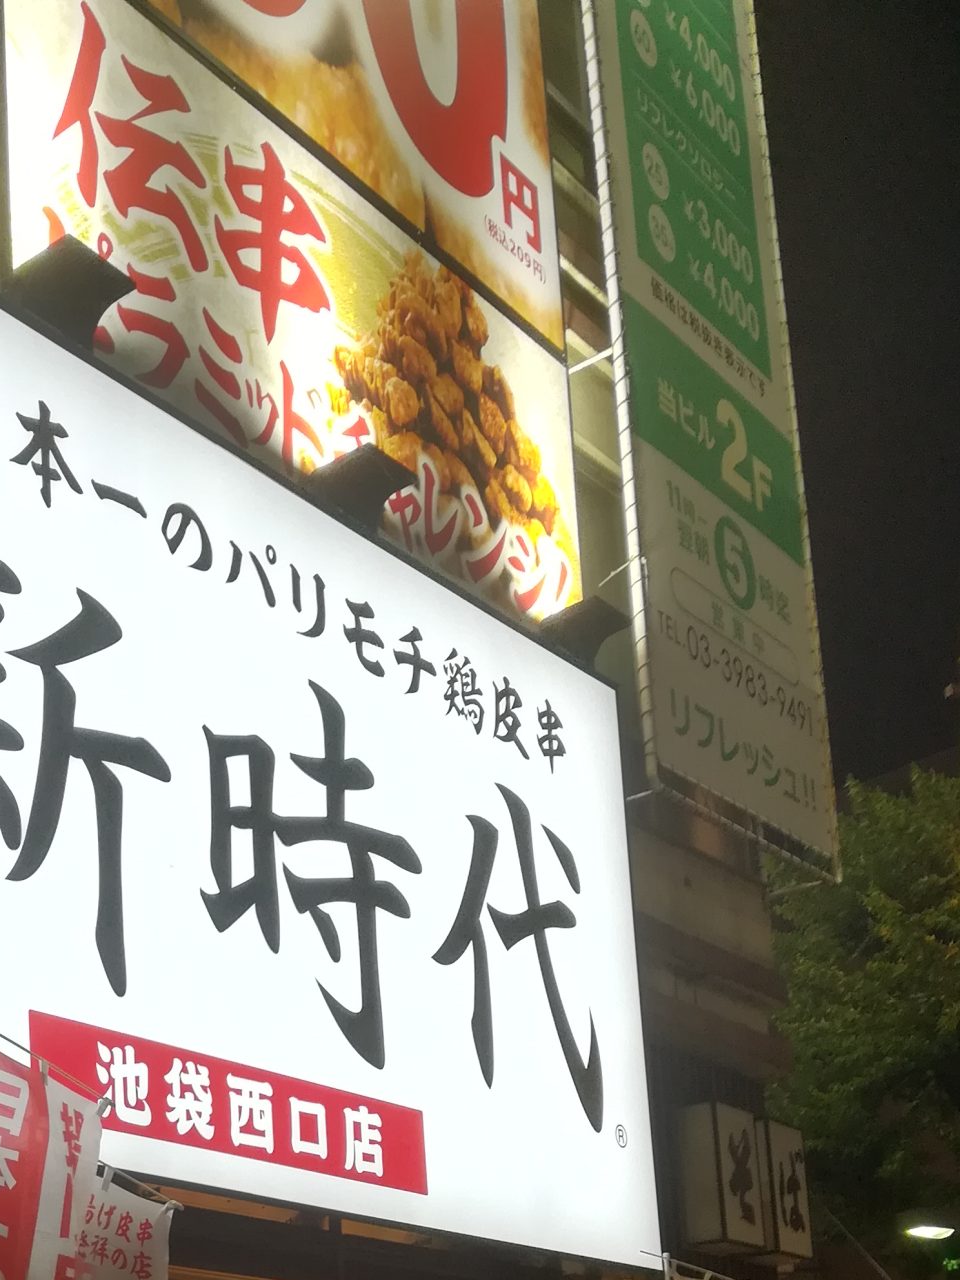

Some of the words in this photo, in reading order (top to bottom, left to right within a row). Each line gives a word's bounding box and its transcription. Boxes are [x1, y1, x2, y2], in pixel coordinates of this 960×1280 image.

[52, 1, 331, 345] 伝串
[716, 398, 774, 514] 2F
[96, 1040, 385, 1178] 池袋西口店
